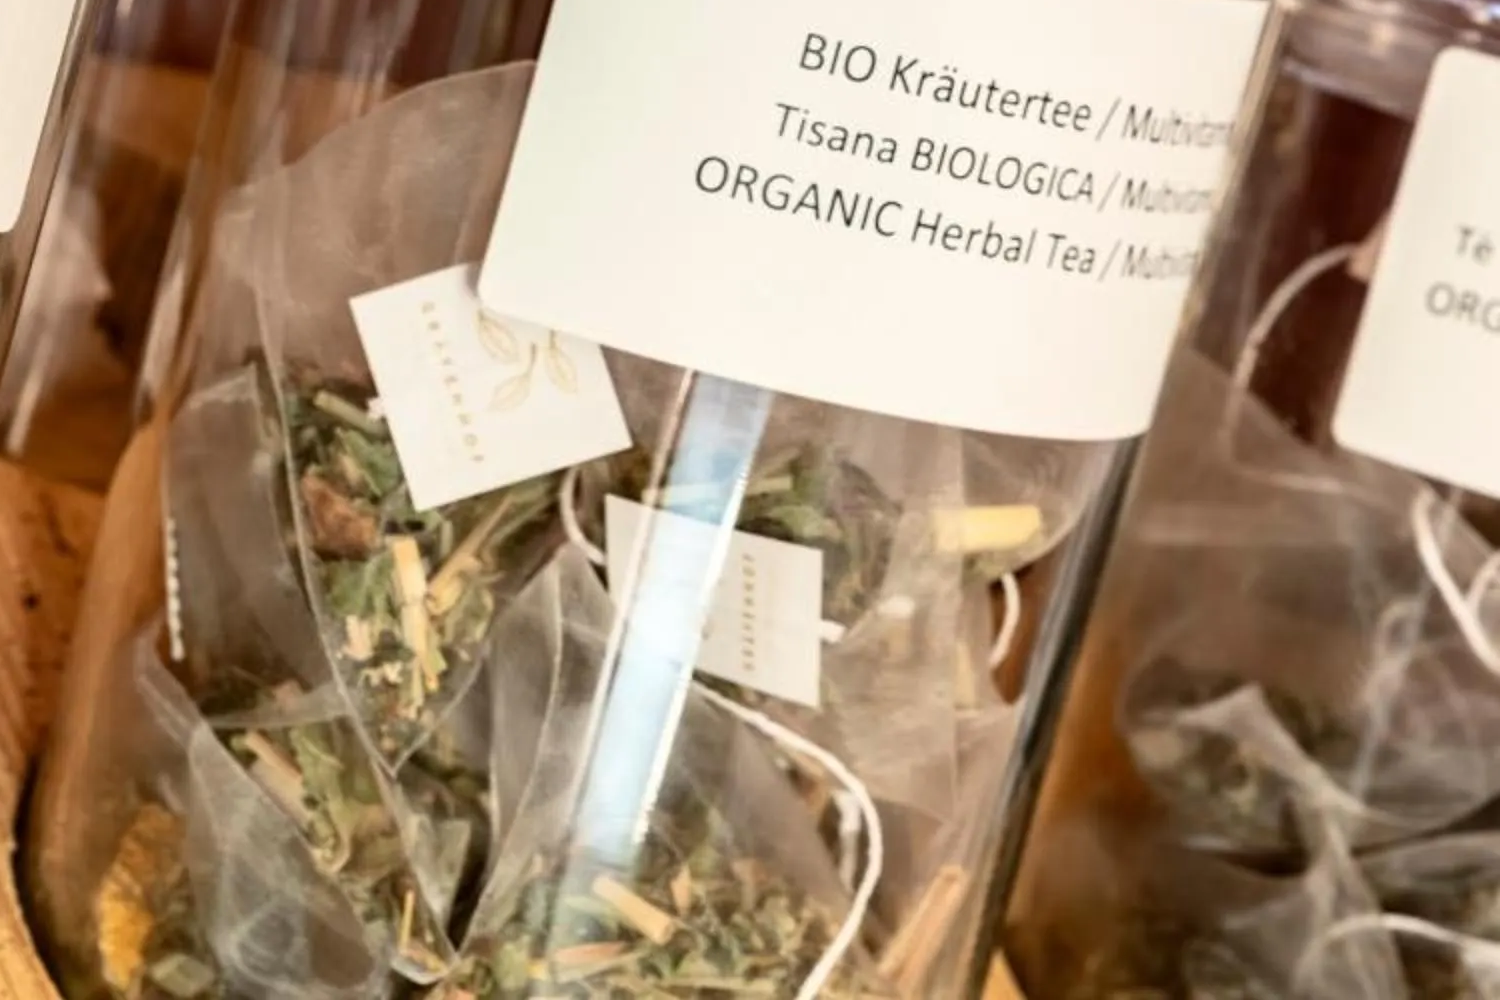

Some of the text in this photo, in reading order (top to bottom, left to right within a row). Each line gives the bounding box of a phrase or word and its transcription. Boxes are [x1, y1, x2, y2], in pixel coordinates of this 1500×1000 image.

[799, 32, 878, 84] BIO
[889, 55, 1093, 132] Kräutertee
[1095, 96, 1122, 142] /
[774, 102, 898, 164] Tisana
[910, 137, 1094, 204] BIOLOGICA
[1097, 171, 1122, 213] /
[694, 155, 903, 238] ORGANIC
[911, 208, 1038, 265] Herbal
[1046, 232, 1096, 275] Tea
[1098, 239, 1122, 282] /
